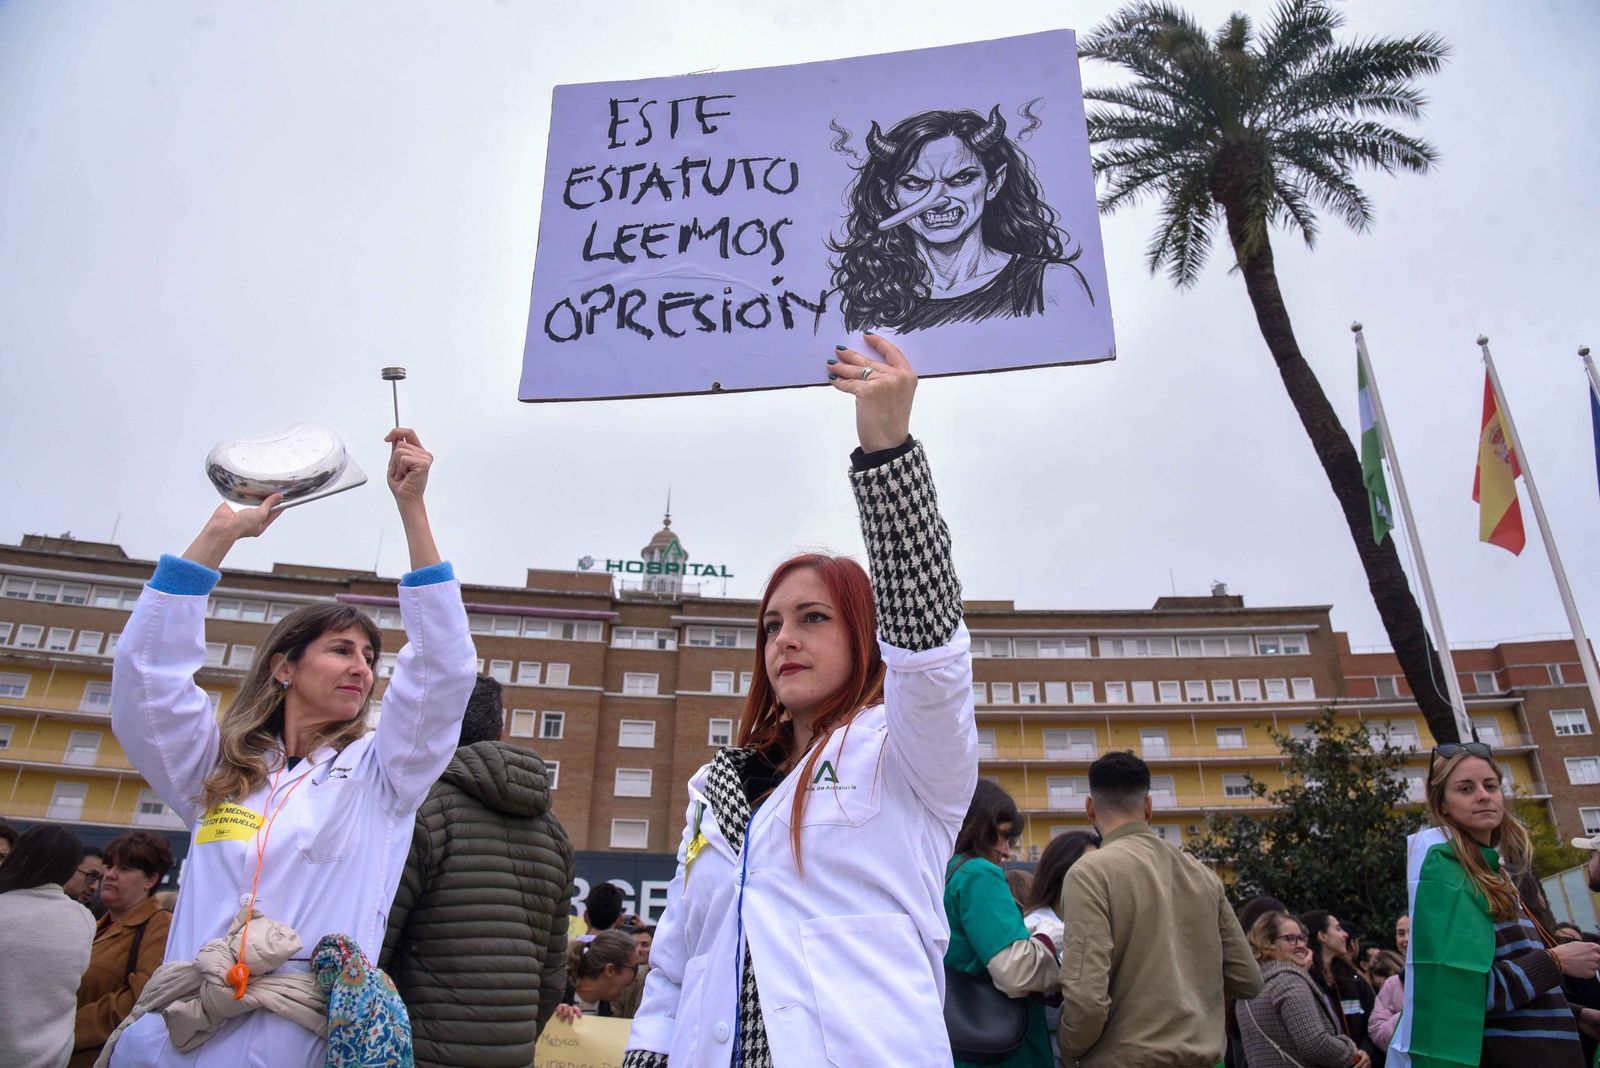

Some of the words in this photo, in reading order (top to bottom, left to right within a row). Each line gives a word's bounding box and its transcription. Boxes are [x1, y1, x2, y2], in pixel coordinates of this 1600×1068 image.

[608, 94, 736, 149] ESTE
[563, 156, 799, 210] ESTATUTO
[582, 217, 794, 266] LEEMOS
[606, 559, 734, 577] HOSPITAL
